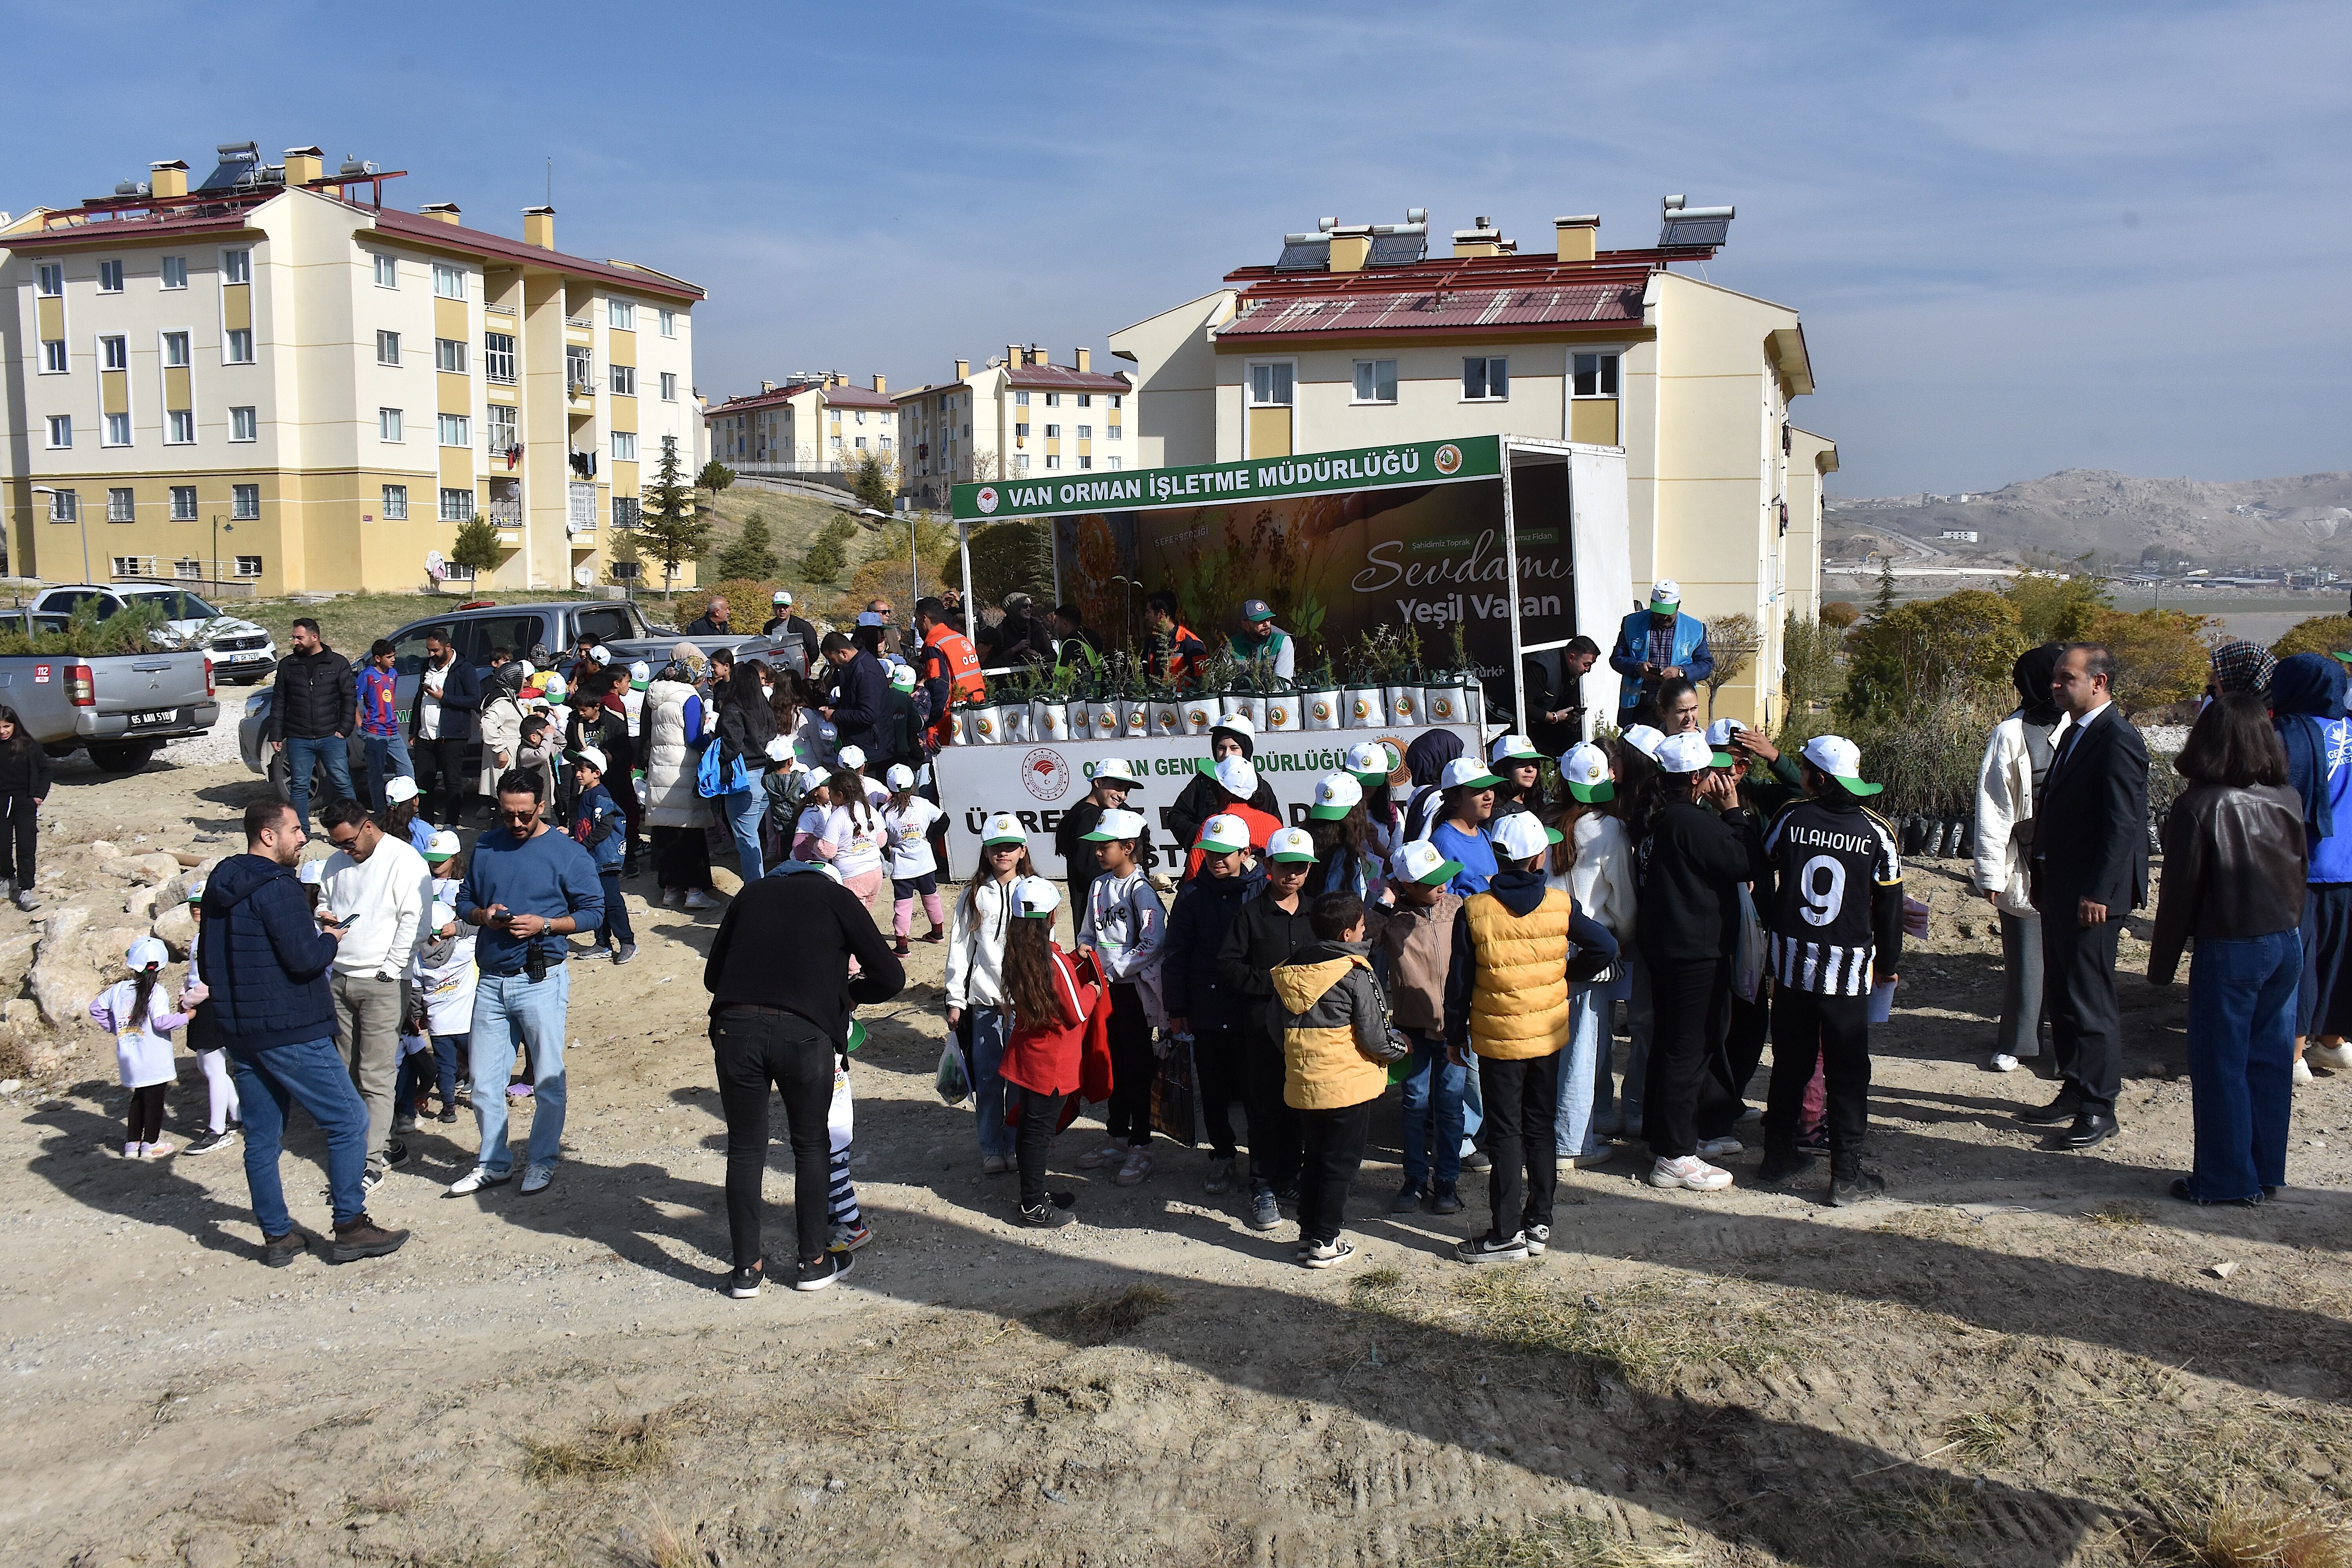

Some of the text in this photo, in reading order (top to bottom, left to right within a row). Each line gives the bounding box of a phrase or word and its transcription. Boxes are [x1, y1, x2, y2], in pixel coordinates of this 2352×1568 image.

[1008, 486, 1053, 507] VAN
[1060, 478, 1141, 502] ORMAN
[1149, 469, 1250, 501] İŞLETME
[1258, 448, 1419, 488] MÜDÜRLÜĞÜ
[1412, 538, 1470, 550] Şahidimiz Toprak
[1351, 528, 1574, 592] Sevdamı
[1396, 593, 1463, 629] Yeşil
[37, 666, 49, 676] 112
[131, 711, 170, 724] 65 AAU 518
[1252, 748, 1347, 772] DÜRLÜĞÜ
[1790, 826, 1872, 855] VLAHOVIĆ
[1799, 855, 1846, 926] 9
